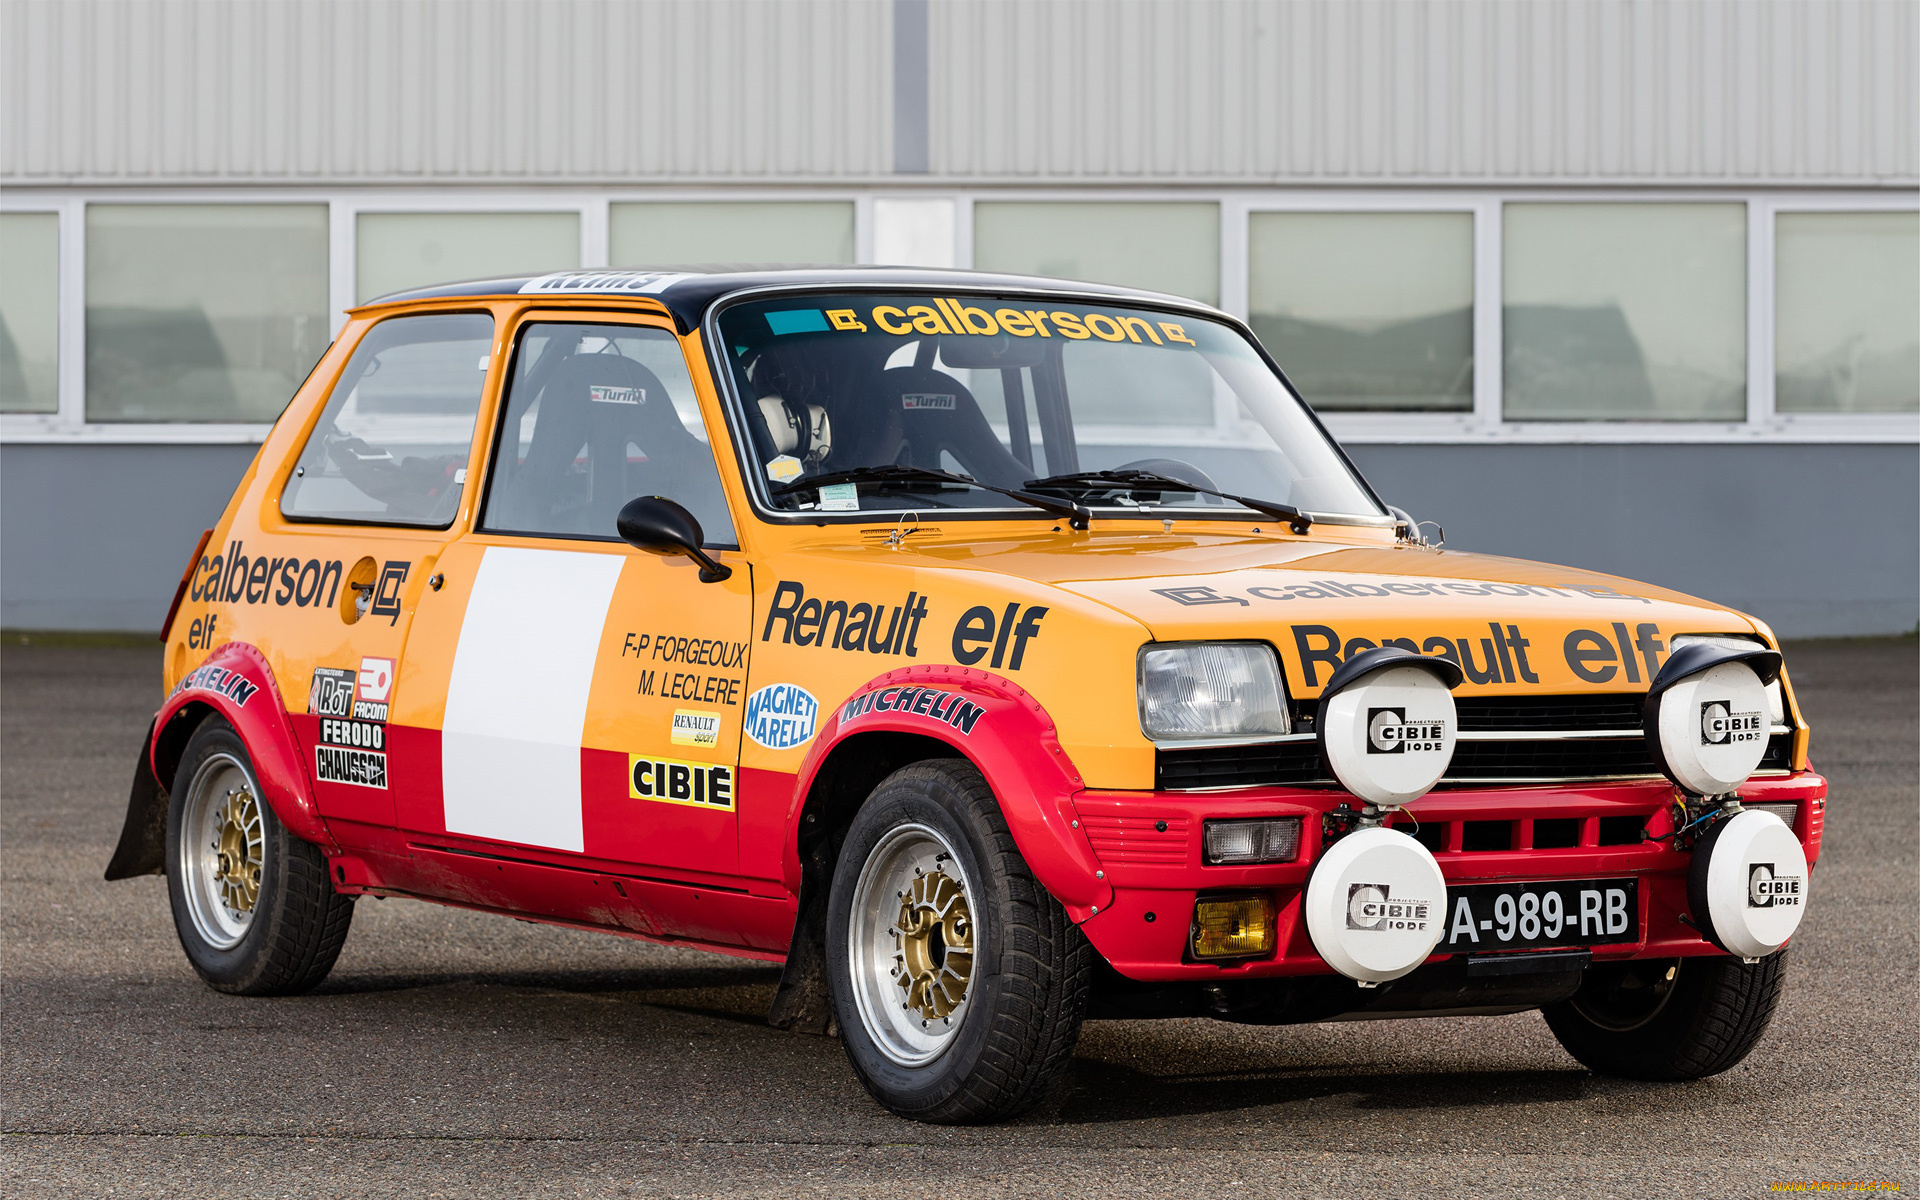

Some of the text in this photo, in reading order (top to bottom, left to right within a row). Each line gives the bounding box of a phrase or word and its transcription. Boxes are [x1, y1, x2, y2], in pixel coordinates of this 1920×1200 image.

[872, 298, 1164, 345] calberson
[191, 541, 343, 608] calberson
[1246, 580, 1575, 601] calberson
[188, 613, 217, 650] elf
[762, 581, 1049, 671] Renault elf
[622, 633, 748, 669] F-P FORGEOUX
[1562, 622, 1665, 684] elf
[638, 670, 741, 706] M. LECLERE
[746, 685, 818, 717] MAGNETI
[353, 702, 388, 720] FACOM
[673, 714, 715, 731] RENAULT
[840, 687, 987, 736] MICHELIN
[323, 719, 382, 749] FERODO
[694, 732, 716, 744] sport
[745, 716, 815, 747] MARELLI
[1407, 743, 1442, 751] IODE
[317, 748, 386, 787] CHAUSSON
[1436, 889, 1629, 944] A-989-RB
[1774, 897, 1799, 905] IODE
